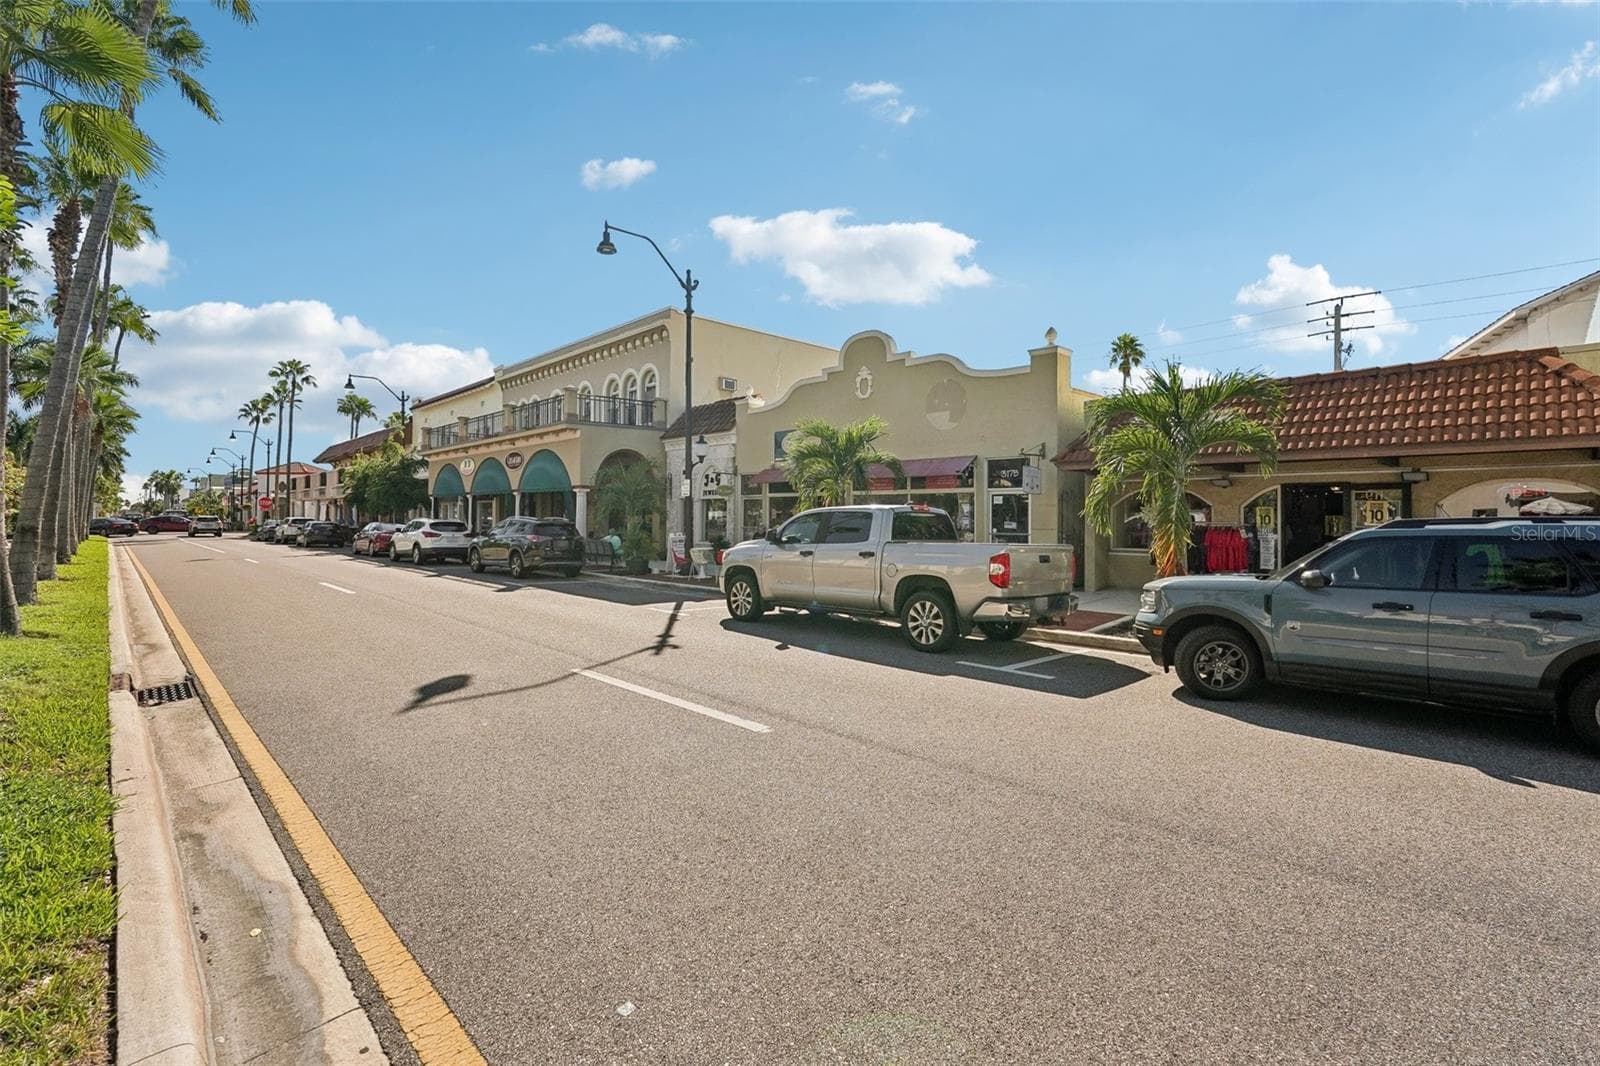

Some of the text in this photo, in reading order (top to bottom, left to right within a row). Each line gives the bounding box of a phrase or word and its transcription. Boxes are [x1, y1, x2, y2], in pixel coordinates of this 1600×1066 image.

[259, 498, 272, 507] STOP
[1258, 514, 1271, 525] 10
[1367, 509, 1384, 523] 10
